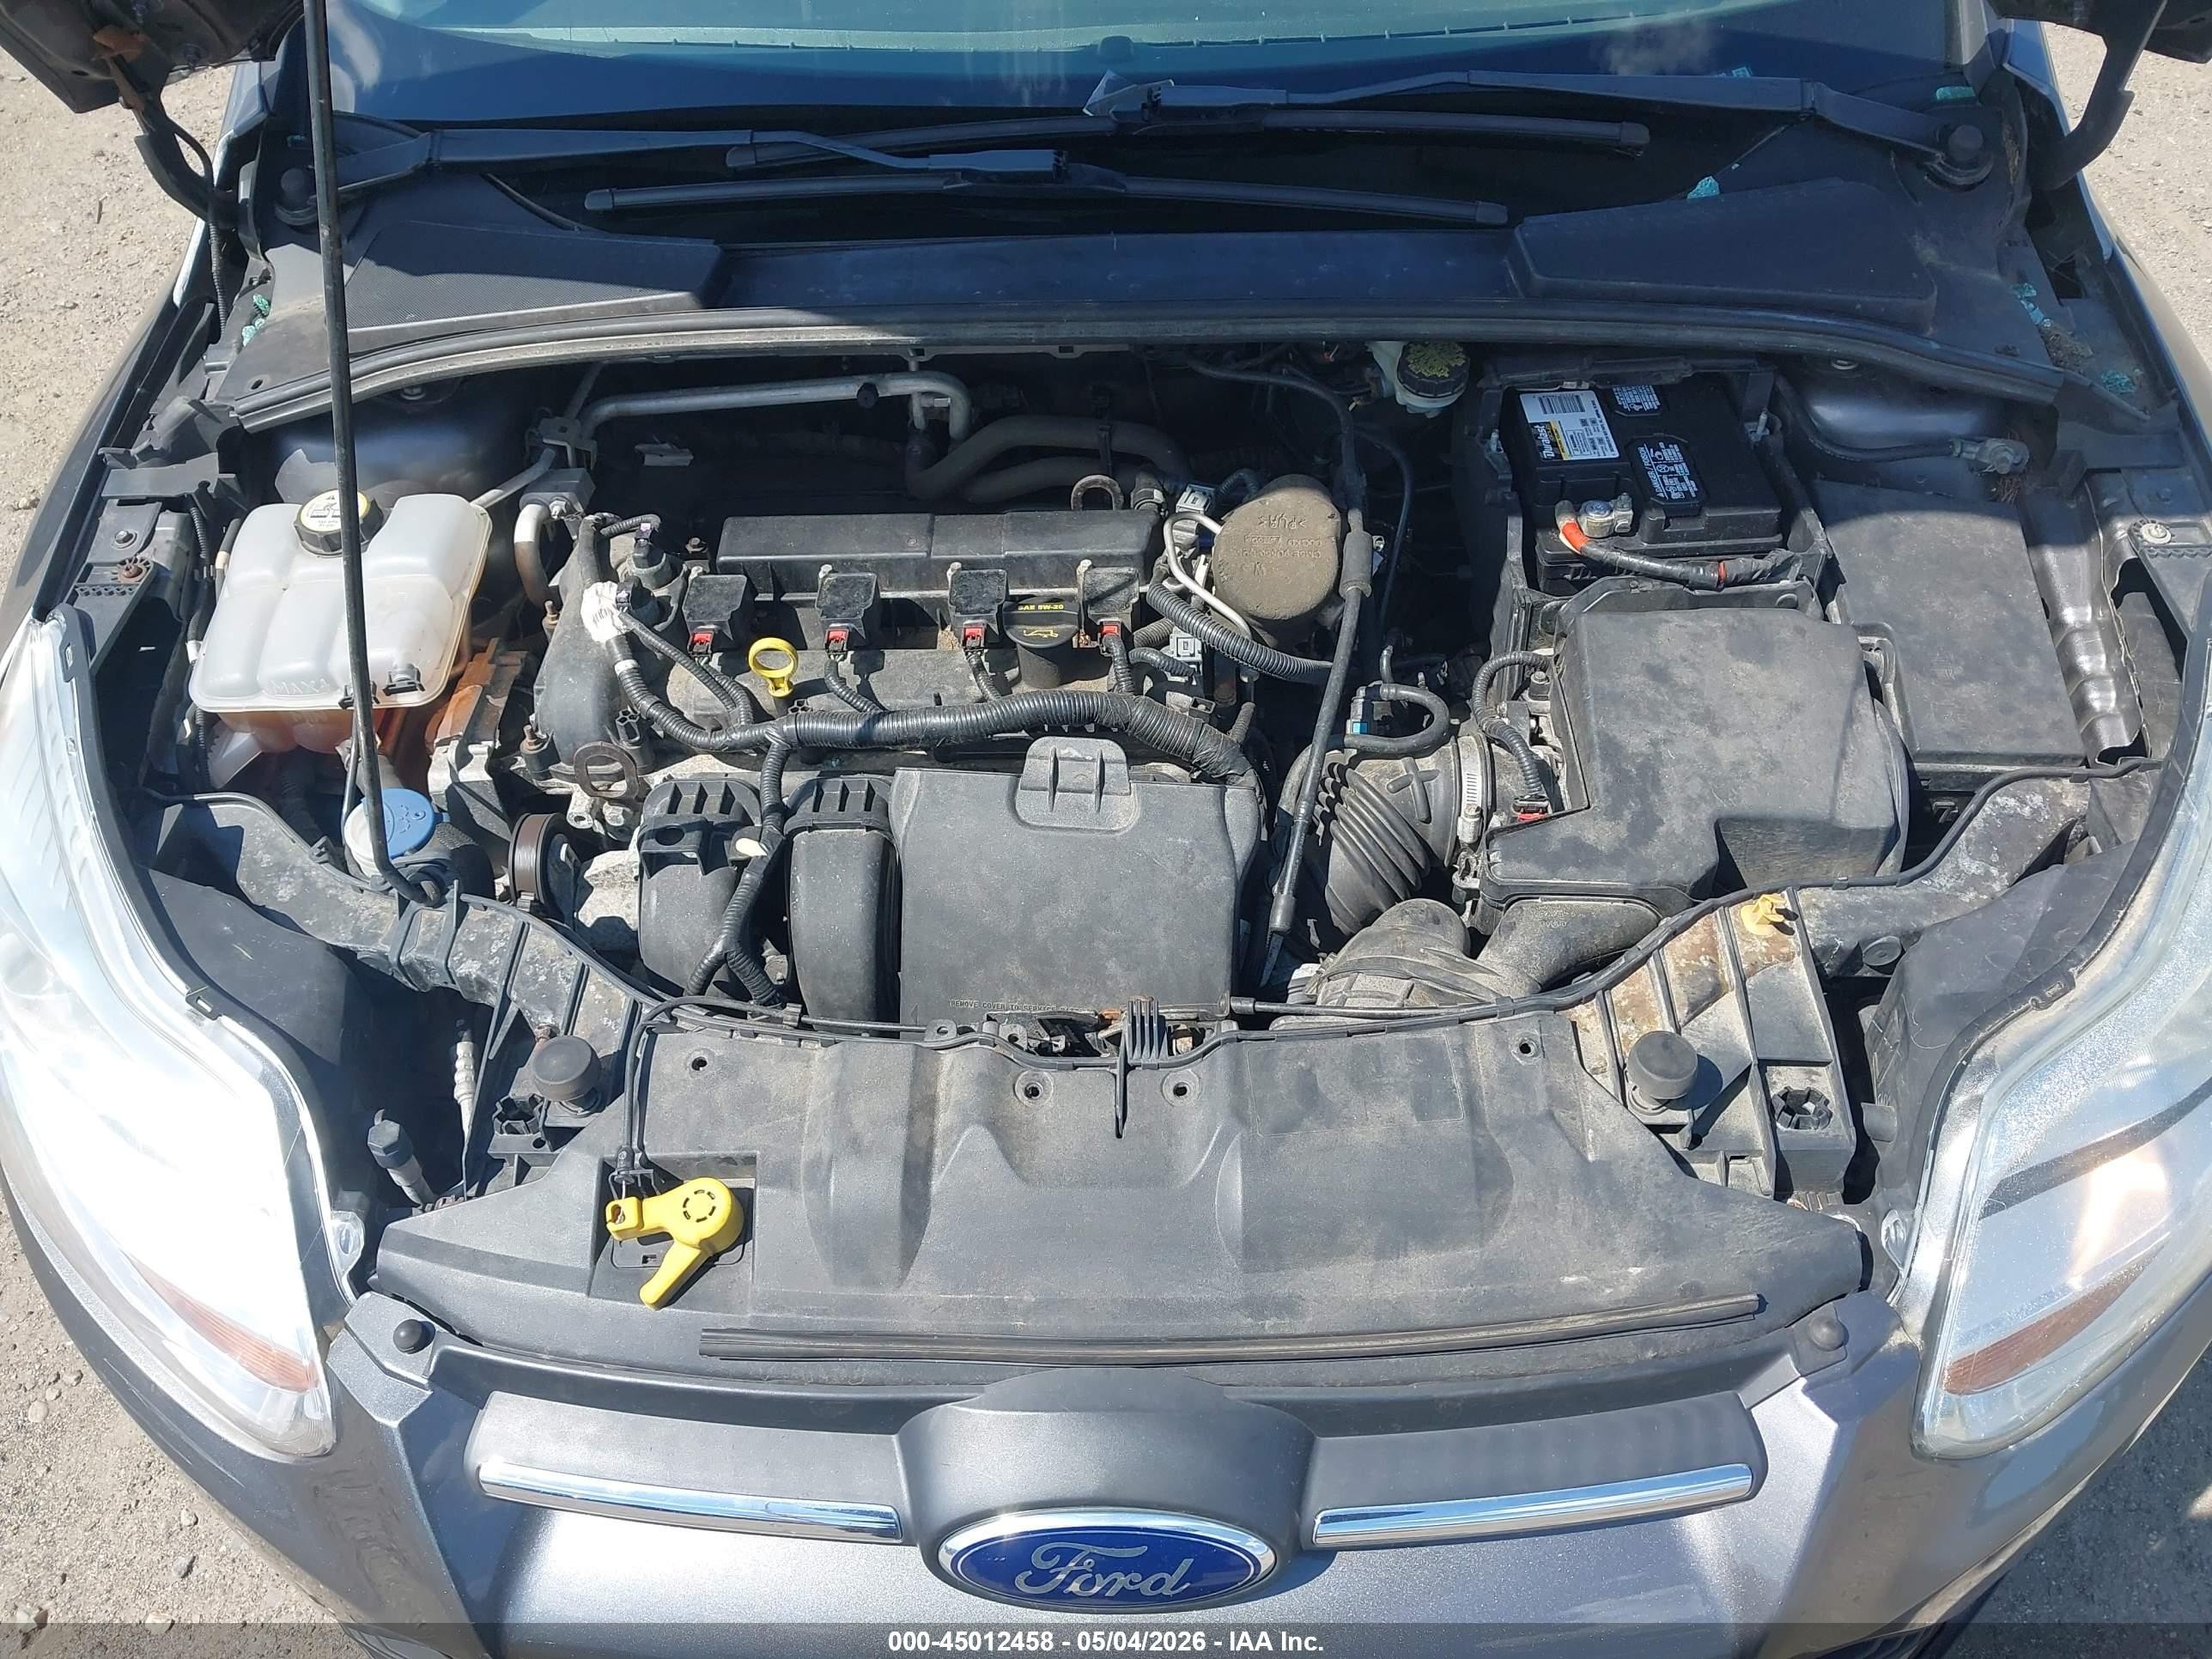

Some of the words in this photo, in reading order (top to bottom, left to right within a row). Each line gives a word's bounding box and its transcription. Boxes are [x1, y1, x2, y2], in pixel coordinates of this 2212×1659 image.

[1534, 424, 1555, 459] Duralast
[1638, 447, 1652, 465] POISON
[1648, 471, 1663, 492] DANGER
[950, 999, 979, 1008] REMOVE
[1015, 1541, 1193, 1598] Ford
